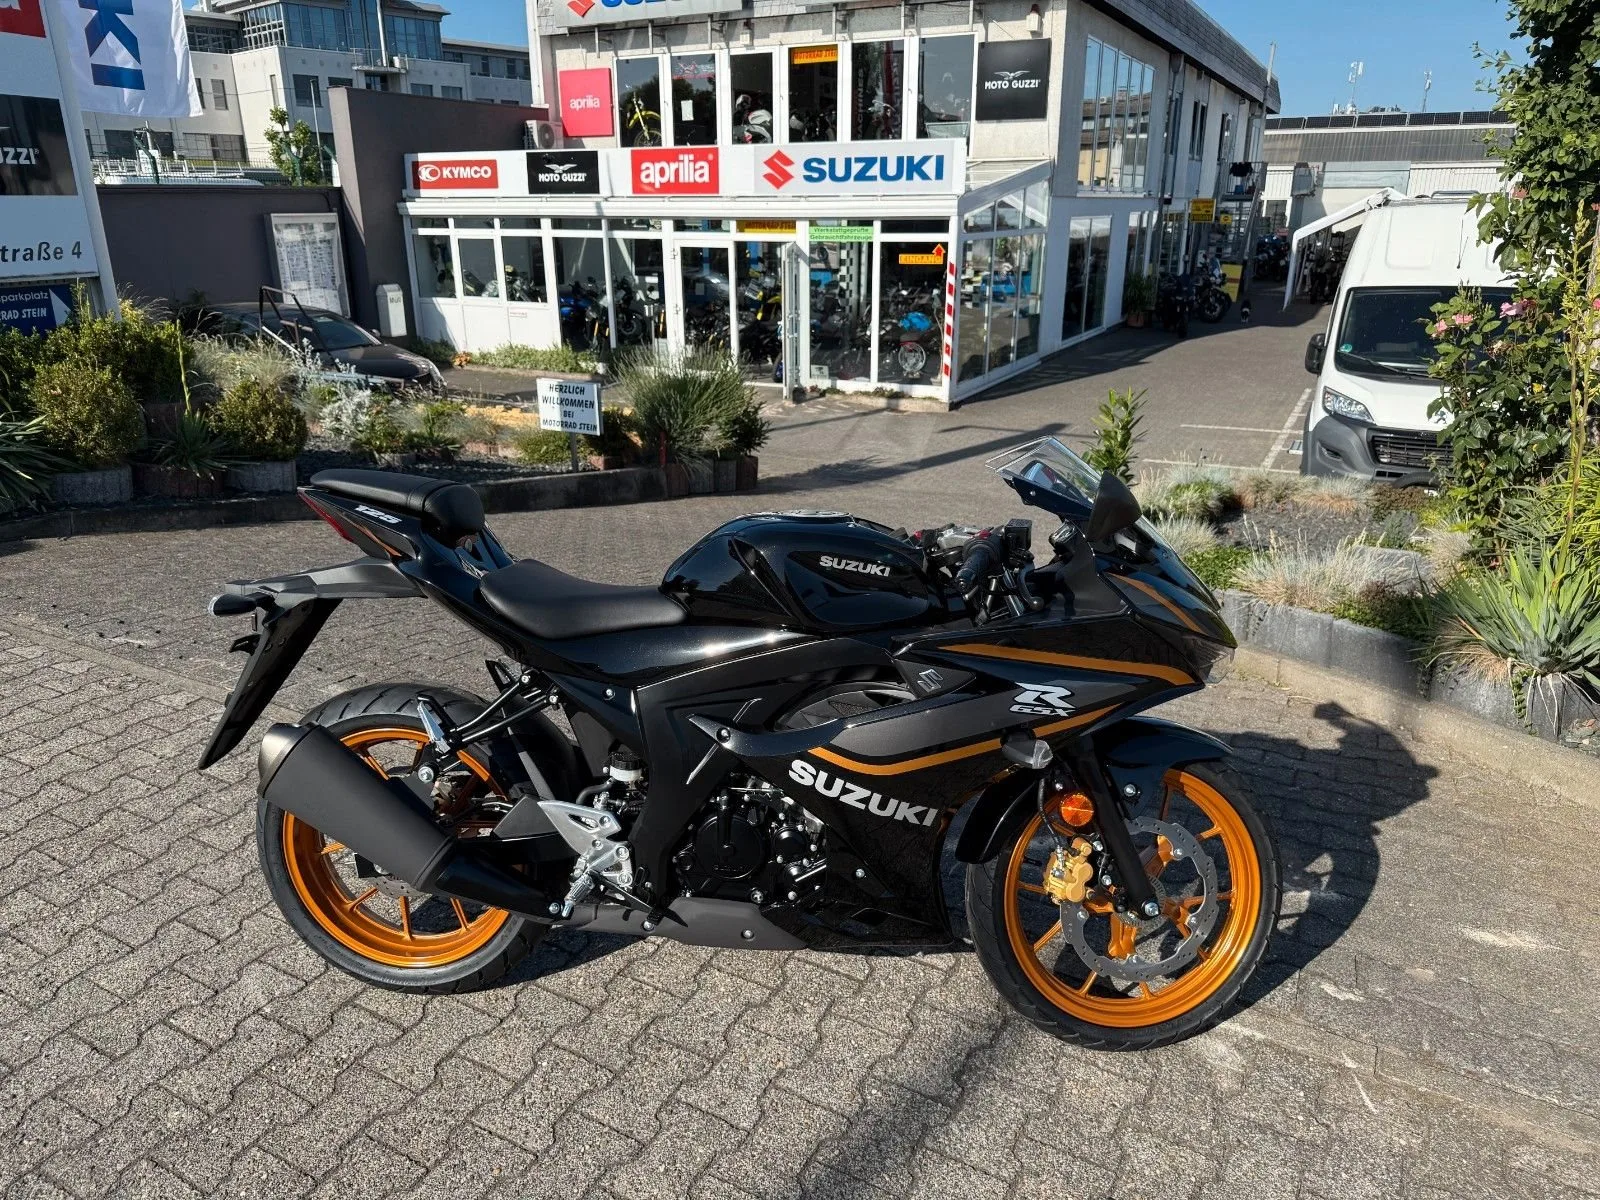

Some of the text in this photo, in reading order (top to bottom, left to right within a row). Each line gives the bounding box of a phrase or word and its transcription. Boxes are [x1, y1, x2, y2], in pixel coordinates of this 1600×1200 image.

[985, 81, 1009, 89] MOTO
[569, 96, 600, 110] aprilia
[442, 165, 492, 179] KYMCO
[640, 154, 710, 188] aprilia
[803, 154, 945, 183] SUZUKI
[538, 173, 559, 182] MOTO
[72, 241, 82, 259] 4
[22, 308, 47, 318] STEIN
[549, 383, 585, 395] HERZLICH
[542, 395, 595, 409] WILLKOMMEN
[563, 410, 574, 418] BEI
[543, 419, 598, 431] MOTORRAD STEIN
[819, 555, 891, 577] SUZUKI
[788, 759, 939, 827] SUZUKI
